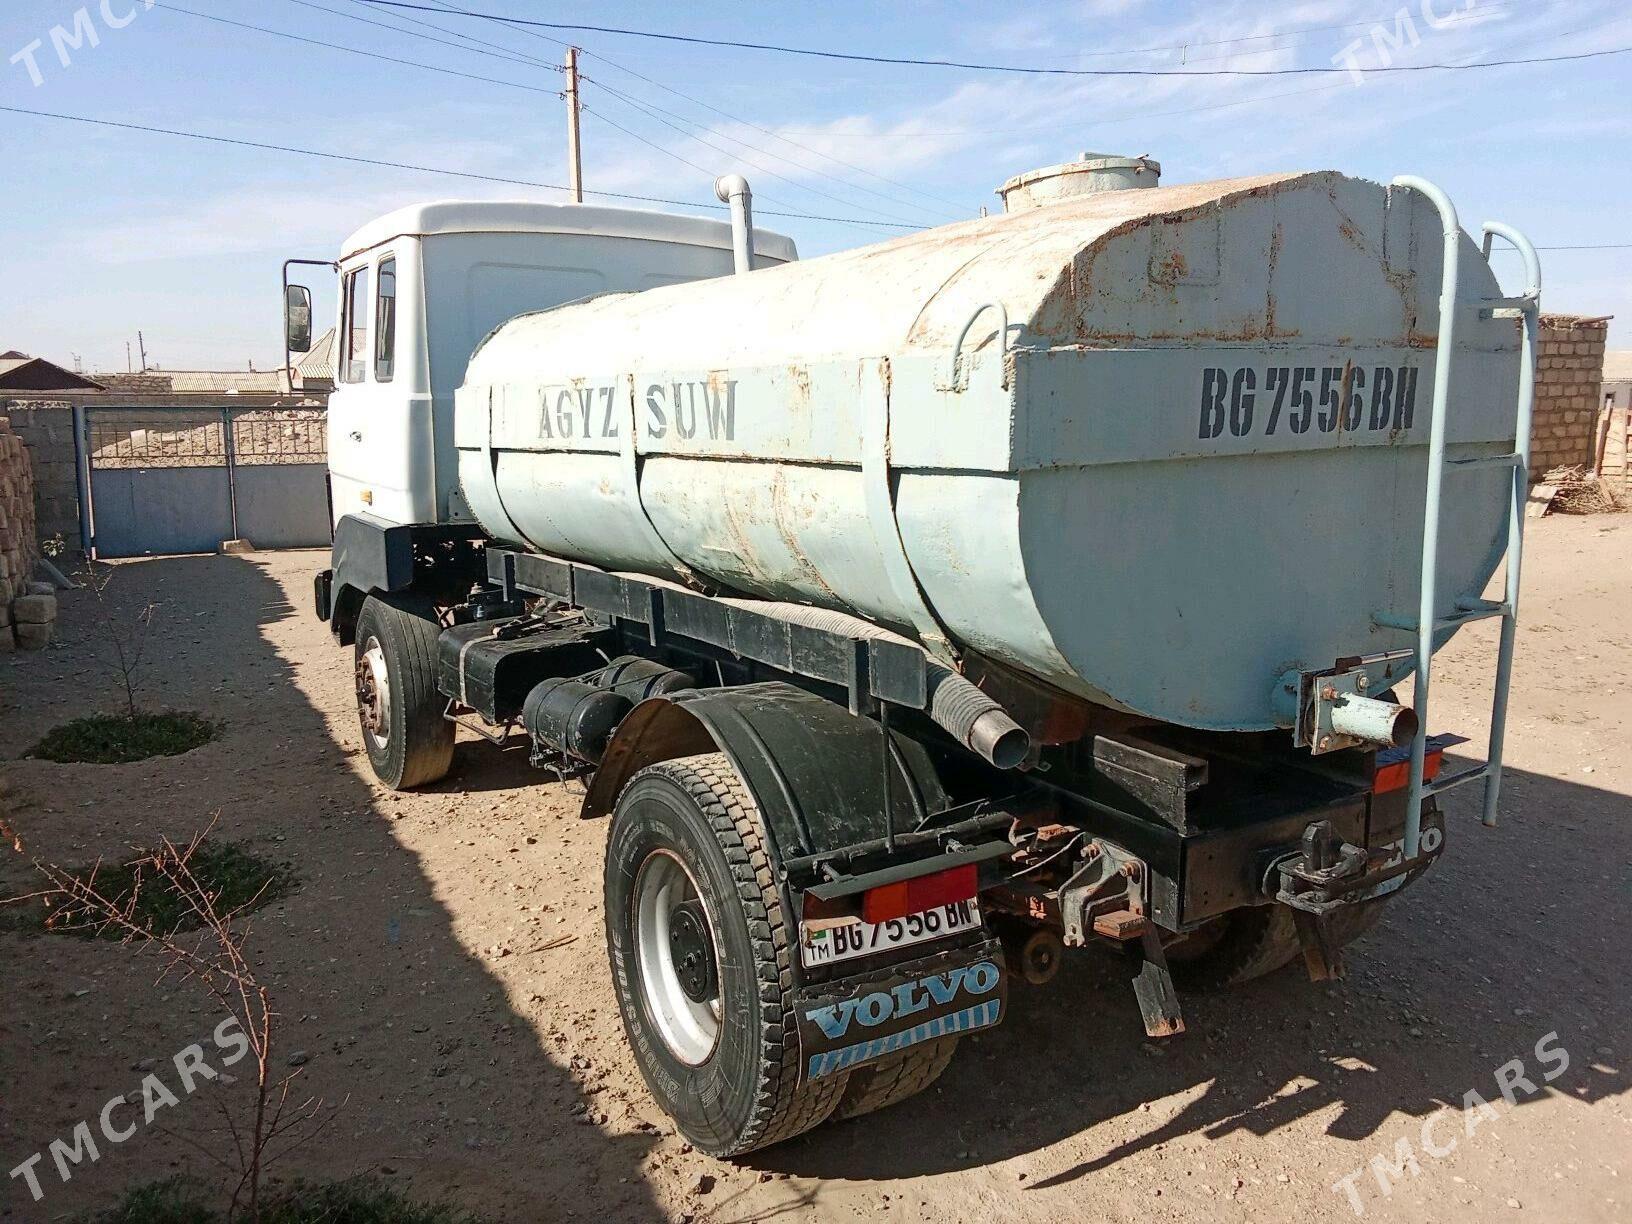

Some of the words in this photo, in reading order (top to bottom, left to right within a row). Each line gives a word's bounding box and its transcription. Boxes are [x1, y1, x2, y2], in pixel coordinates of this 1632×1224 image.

[538, 386, 618, 439] AGYZ
[646, 380, 738, 440] SUW
[809, 943, 830, 961] TM
[805, 962, 1000, 1039] VOLVO
